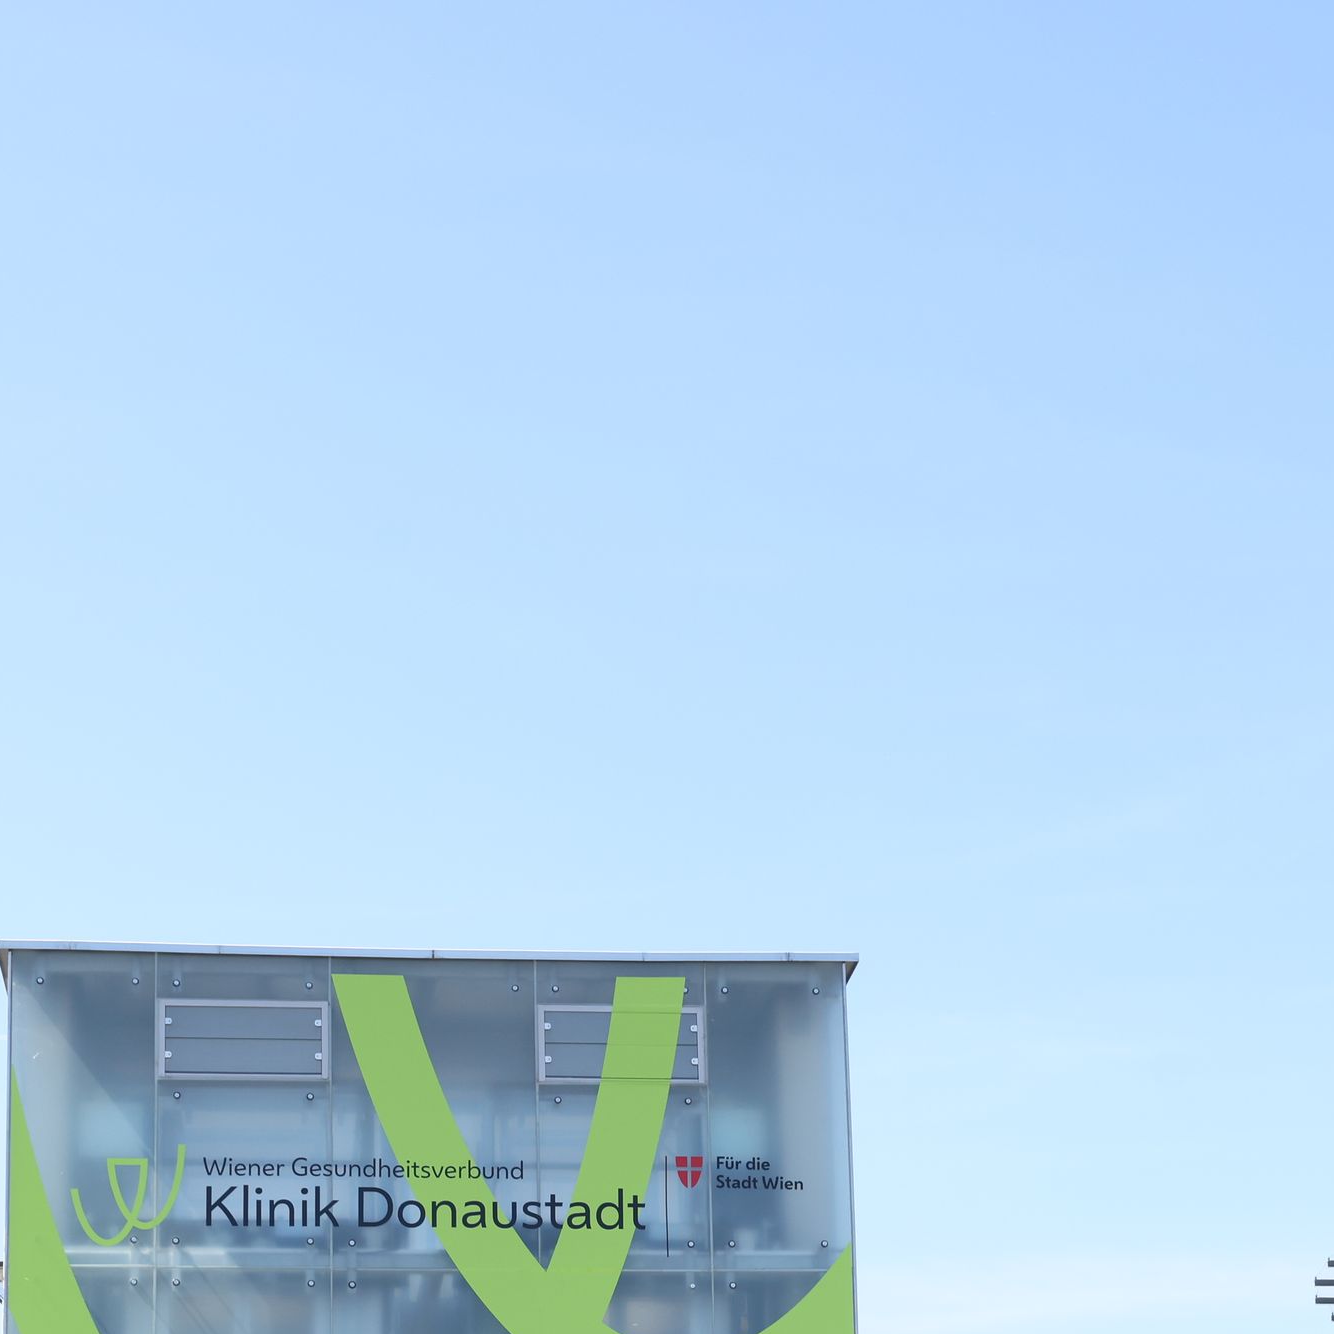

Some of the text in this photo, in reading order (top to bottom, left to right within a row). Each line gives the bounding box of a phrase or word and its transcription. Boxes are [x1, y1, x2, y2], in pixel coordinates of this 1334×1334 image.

[203, 1156, 525, 1180] Wiener Gesundheitsverbund
[716, 1156, 771, 1171] Für die
[716, 1174, 804, 1191] Stadt Wien
[205, 1184, 646, 1230] Klinik Donaustadt
